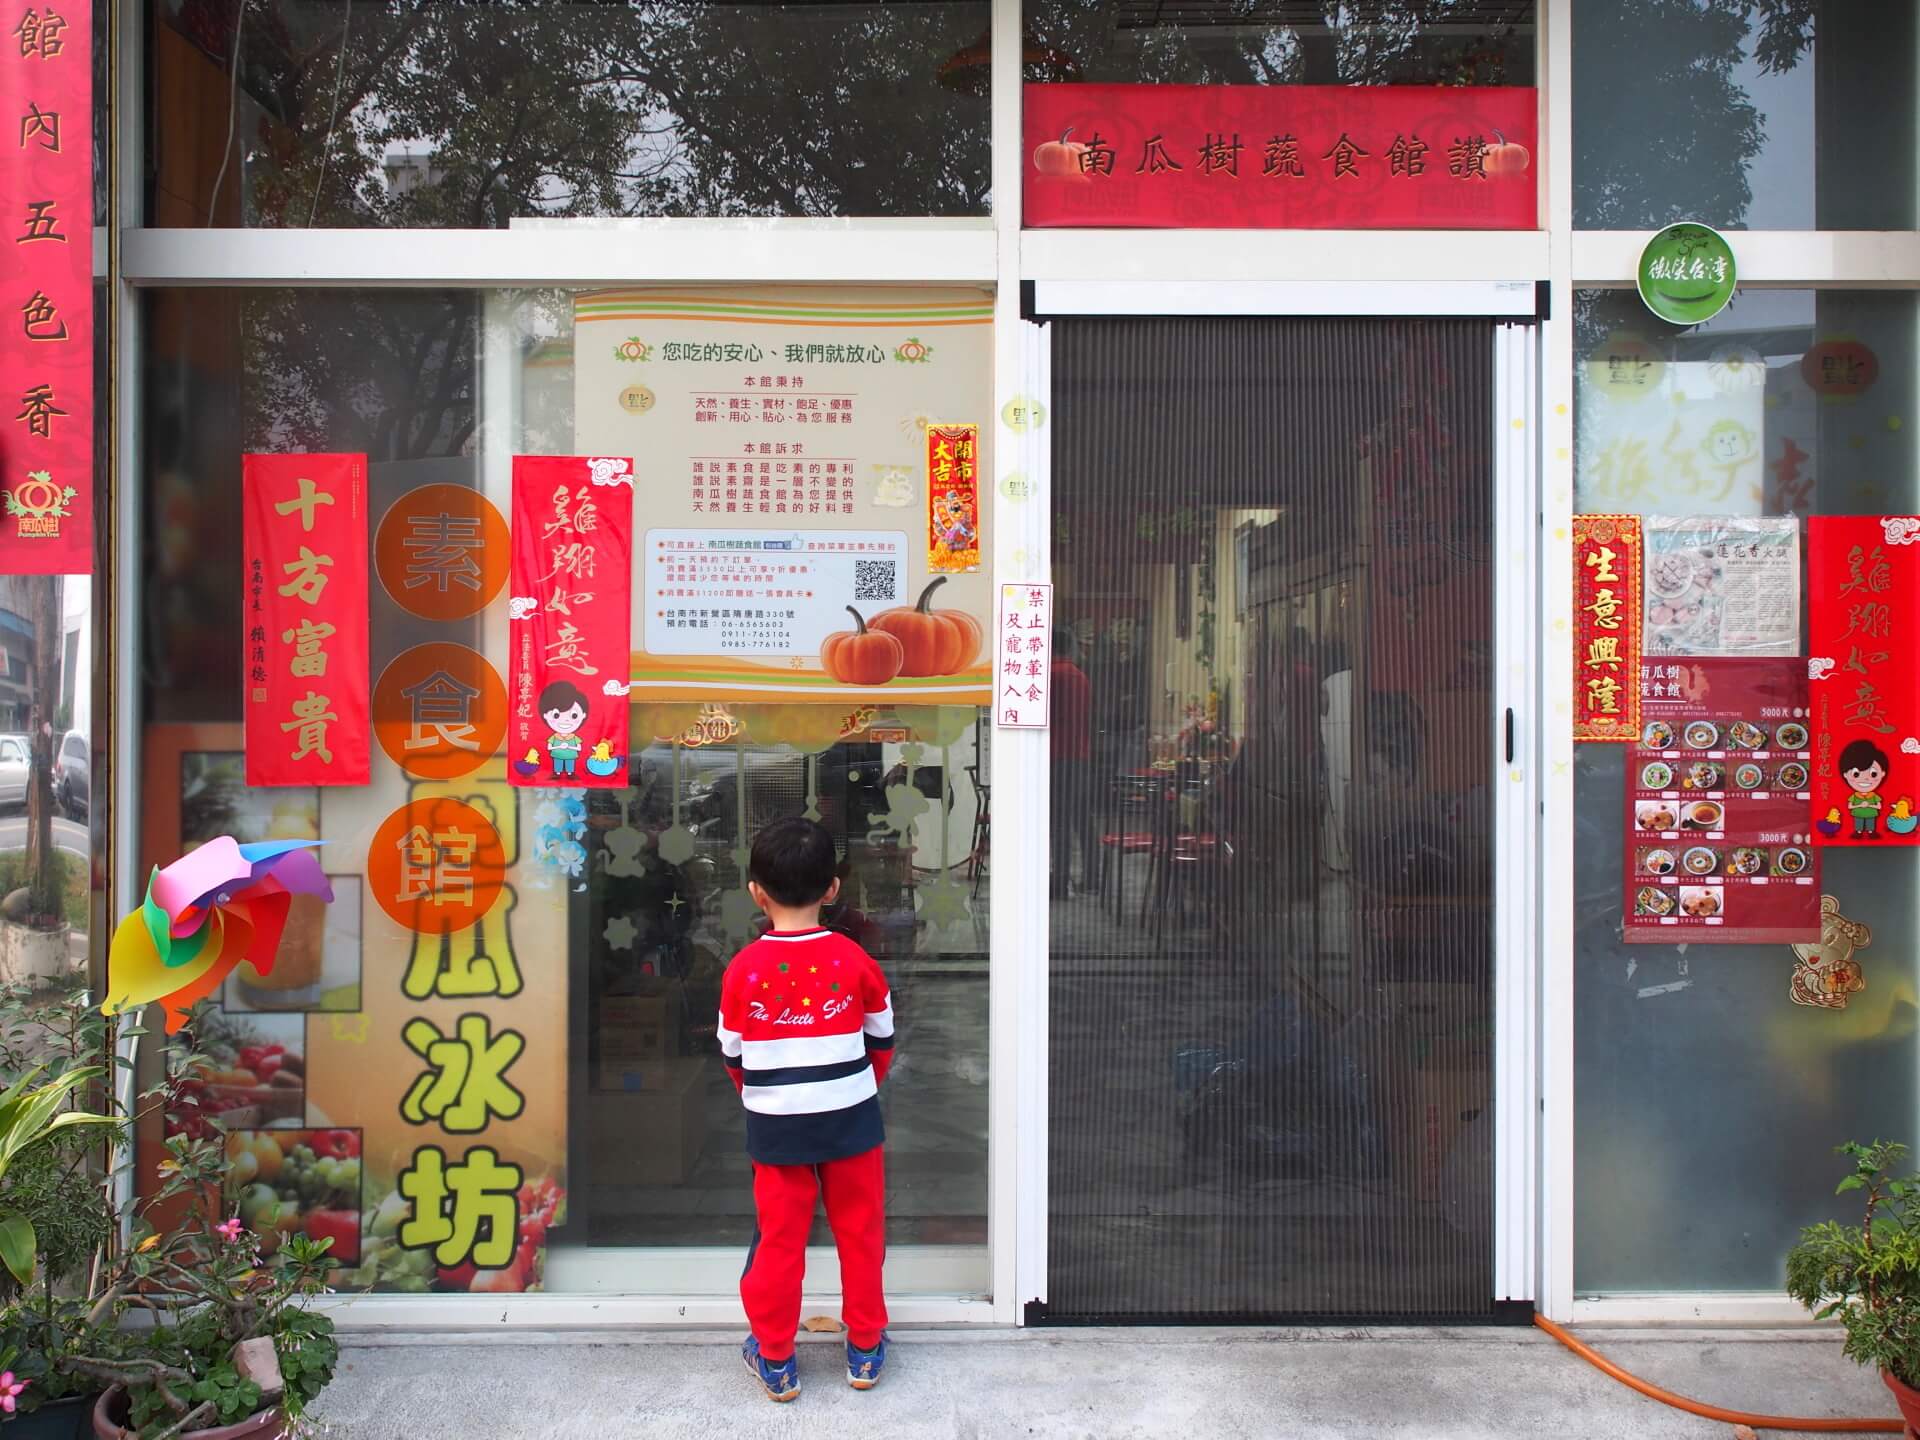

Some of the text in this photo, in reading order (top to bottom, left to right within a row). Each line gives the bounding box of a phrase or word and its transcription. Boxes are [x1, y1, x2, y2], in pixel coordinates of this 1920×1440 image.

[1077, 132, 1490, 181] 南瓜樹蔬食館讚
[15, 7, 69, 438] 館內五色香
[662, 342, 886, 364] 您吃的安心、我們就放心
[744, 376, 804, 388] 本館秉持
[743, 442, 804, 455] 本館訴求
[692, 462, 853, 474] 誰說素食是吃素的專利
[692, 489, 853, 500] 南瓜樹蔬食館為您提供
[692, 502, 853, 514] 天然養生輕食的好料理
[274, 479, 338, 763] 十方富貴
[1583, 546, 1624, 714] 生意興隆
[1025, 588, 1044, 702] 禁止帶葷食
[395, 513, 487, 908] 素食館
[748, 993, 853, 1026] The Little Star
